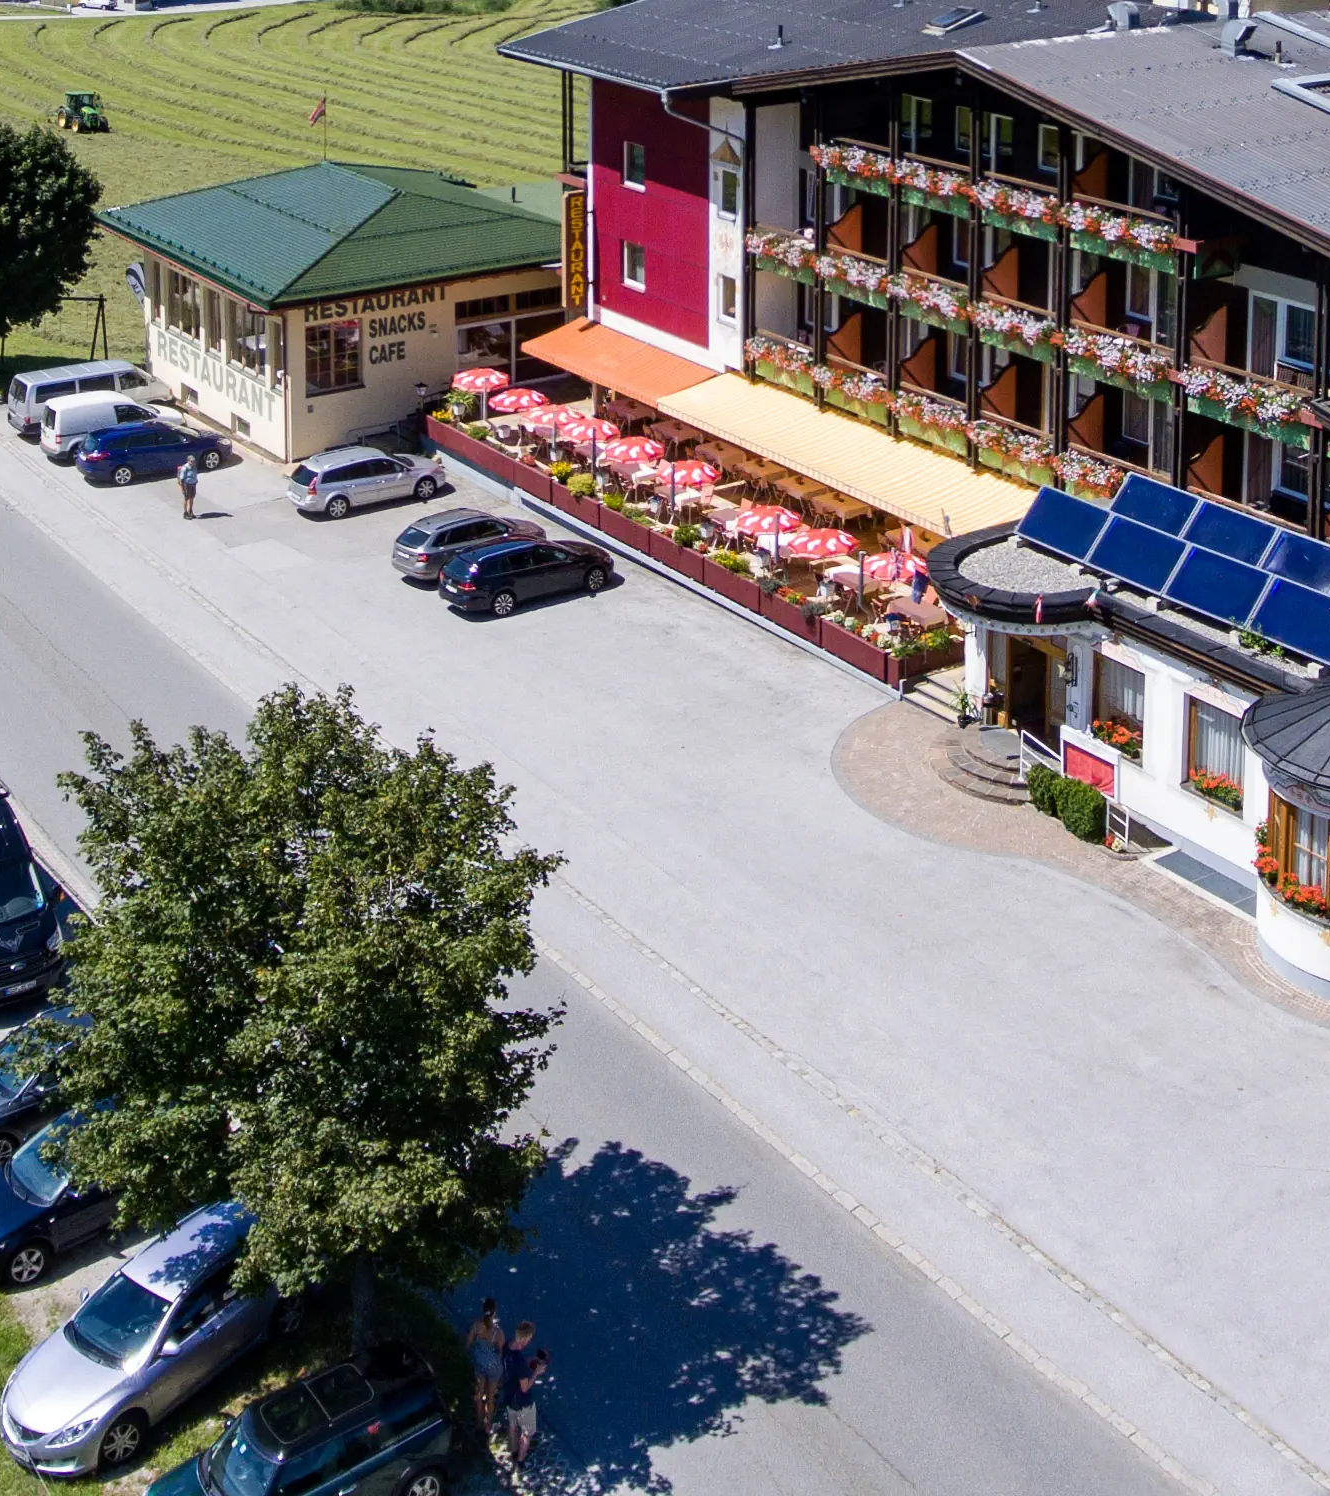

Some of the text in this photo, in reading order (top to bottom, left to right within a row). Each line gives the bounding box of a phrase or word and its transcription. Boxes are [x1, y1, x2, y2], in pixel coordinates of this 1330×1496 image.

[570, 196, 584, 306] RESTAURANT
[304, 285, 446, 322] RESTAURANT
[369, 311, 426, 338] SNACKS
[369, 341, 406, 365] CAFE
[157, 330, 275, 422] RESTAURANT
